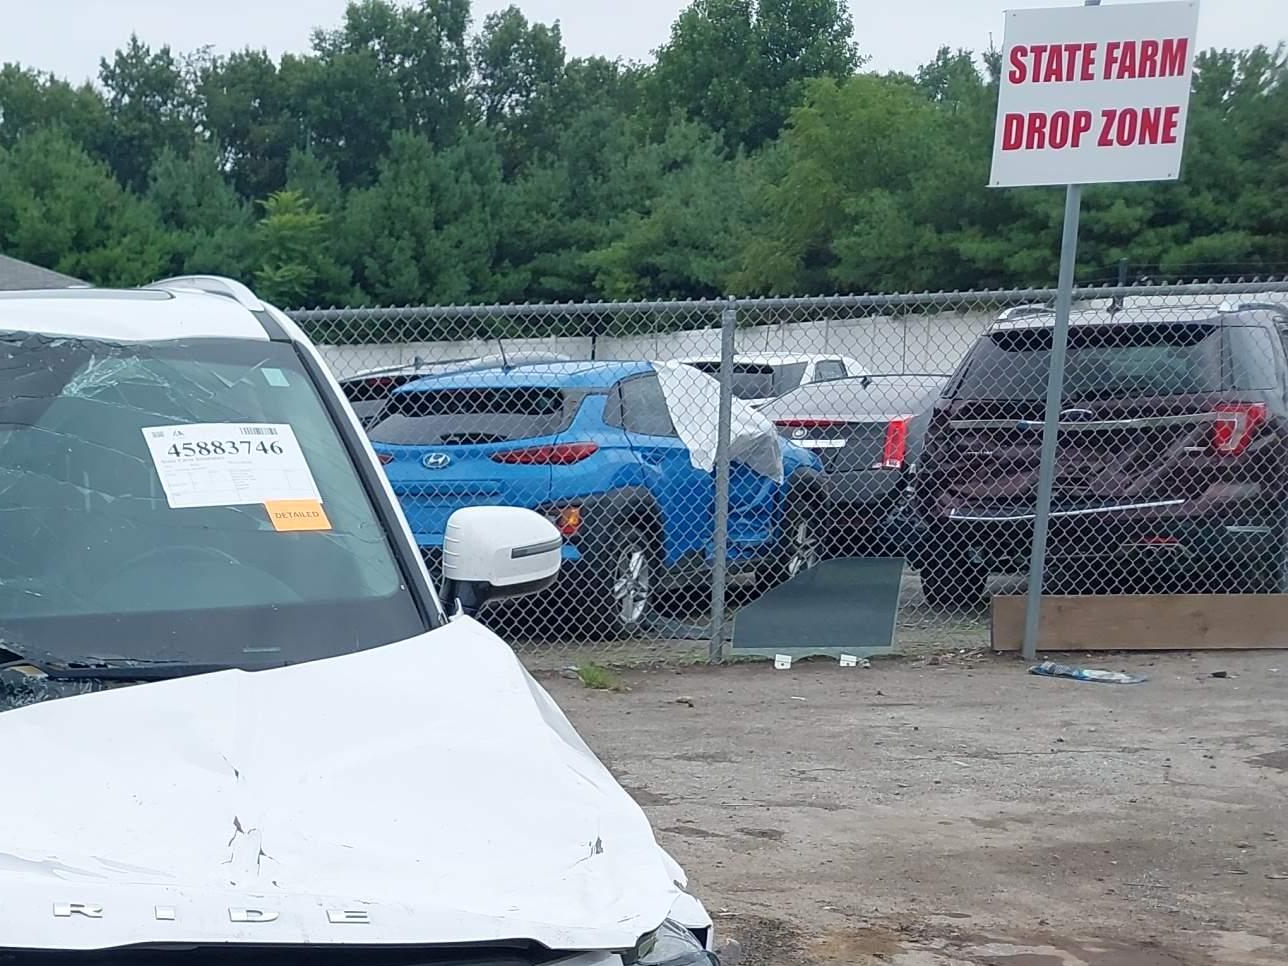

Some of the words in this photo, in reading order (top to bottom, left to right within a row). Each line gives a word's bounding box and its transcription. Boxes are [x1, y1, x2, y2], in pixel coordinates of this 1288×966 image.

[1008, 42, 1097, 84] STATE
[1103, 38, 1189, 80] FARM
[1002, 110, 1092, 151] DROP
[1097, 106, 1180, 147] ZONE
[167, 440, 284, 457] 45883746
[274, 511, 320, 519] DETAILED
